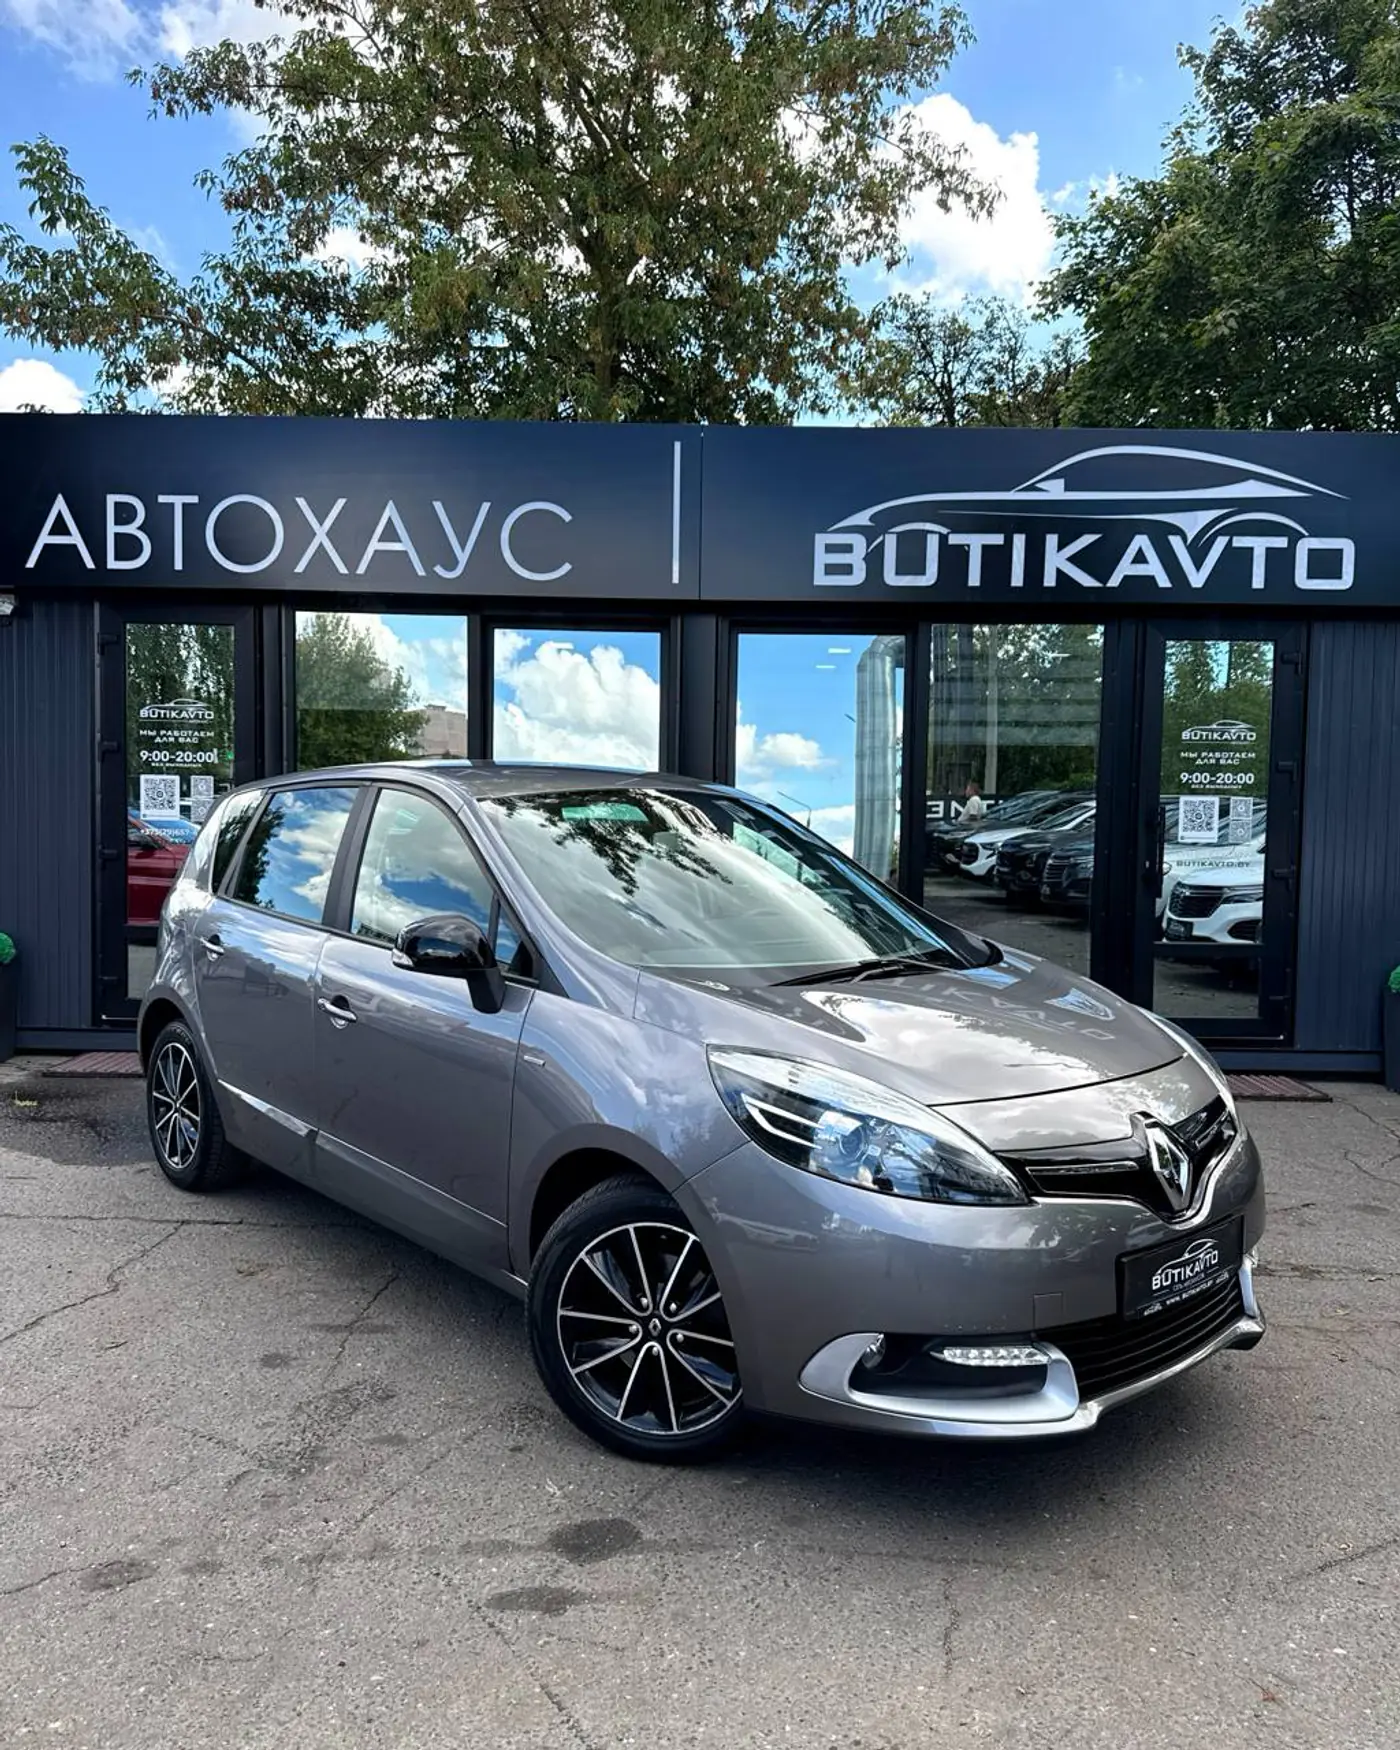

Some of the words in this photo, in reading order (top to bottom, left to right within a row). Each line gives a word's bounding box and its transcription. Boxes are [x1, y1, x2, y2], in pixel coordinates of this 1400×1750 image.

[25, 493, 574, 582] АВТОХАУС
[813, 532, 1356, 591] BUTIKAVTO
[140, 709, 214, 719] BUTIKAVTO
[1181, 731, 1256, 741] BUTIKAVTO
[140, 750, 214, 762] 9:00-20:00
[1180, 772, 1255, 784] 9:00-20:00
[1152, 1250, 1218, 1290] BUTIKAVTO
